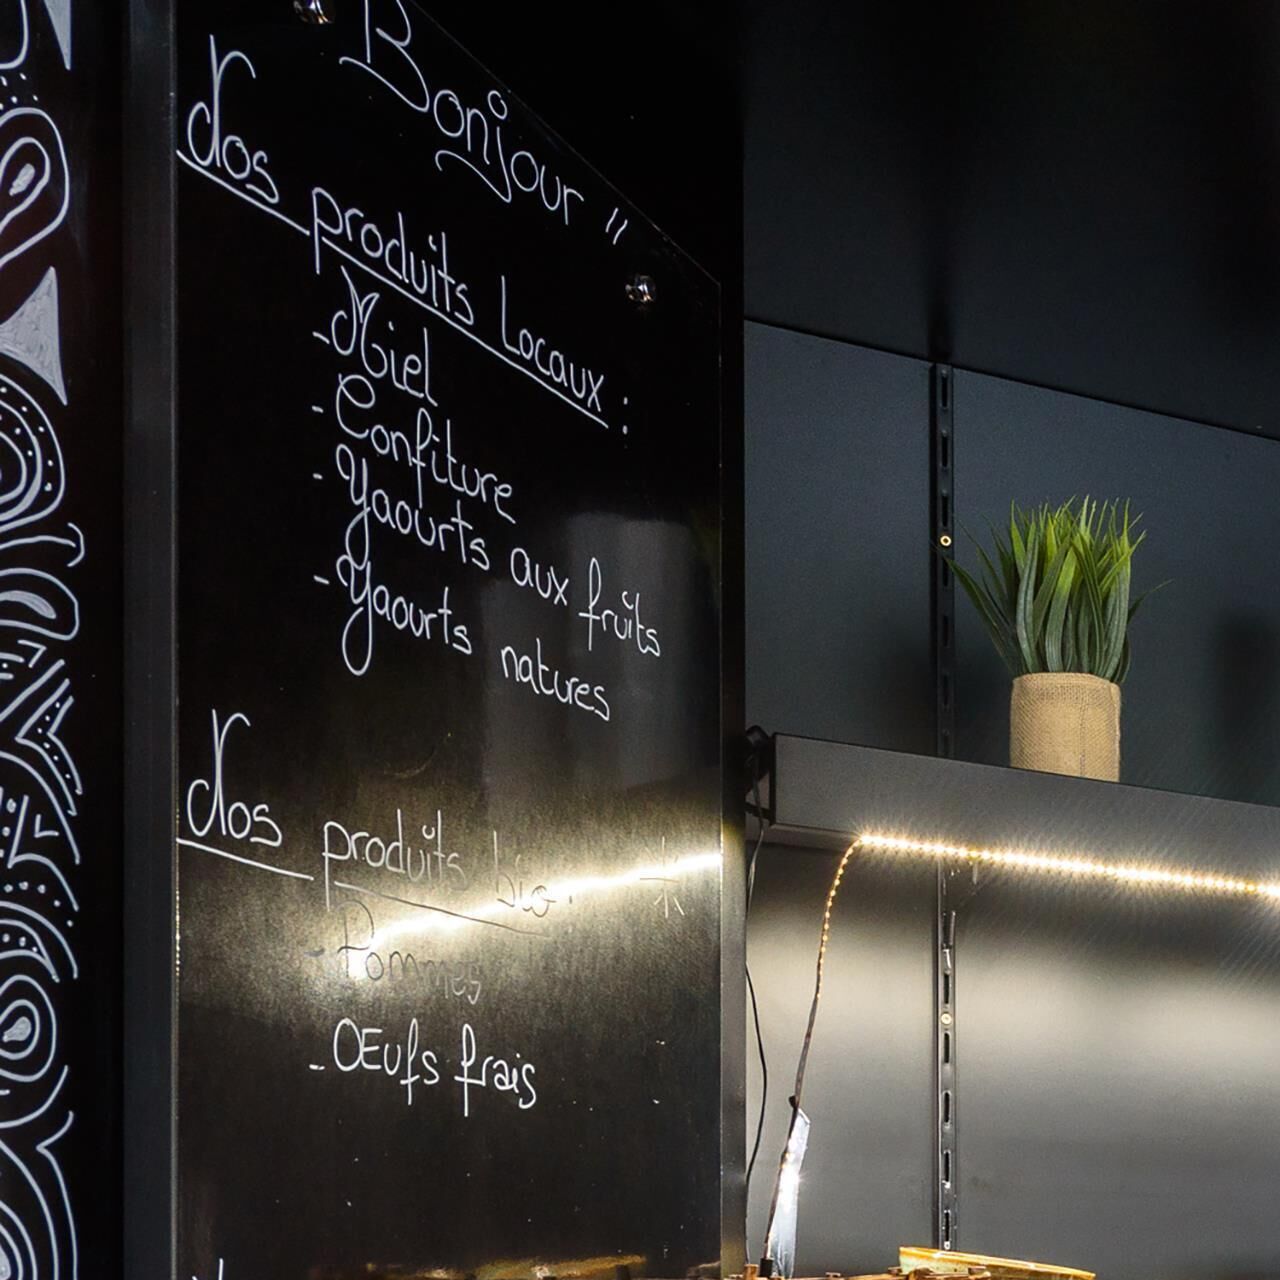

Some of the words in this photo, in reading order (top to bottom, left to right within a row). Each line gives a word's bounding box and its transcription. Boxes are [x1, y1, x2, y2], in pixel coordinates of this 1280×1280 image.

[339, 0, 584, 224] Bonjour
[311, 187, 474, 325] produits
[331, 266, 437, 405] Miel
[336, 373, 515, 524] Confiture
[510, 547, 569, 606] aux
[578, 557, 661, 657] fruits
[501, 643, 610, 721] natures
[321, 808, 467, 912] produits
[338, 899, 482, 1005] Pommes
[455, 1023, 537, 1117] frais
